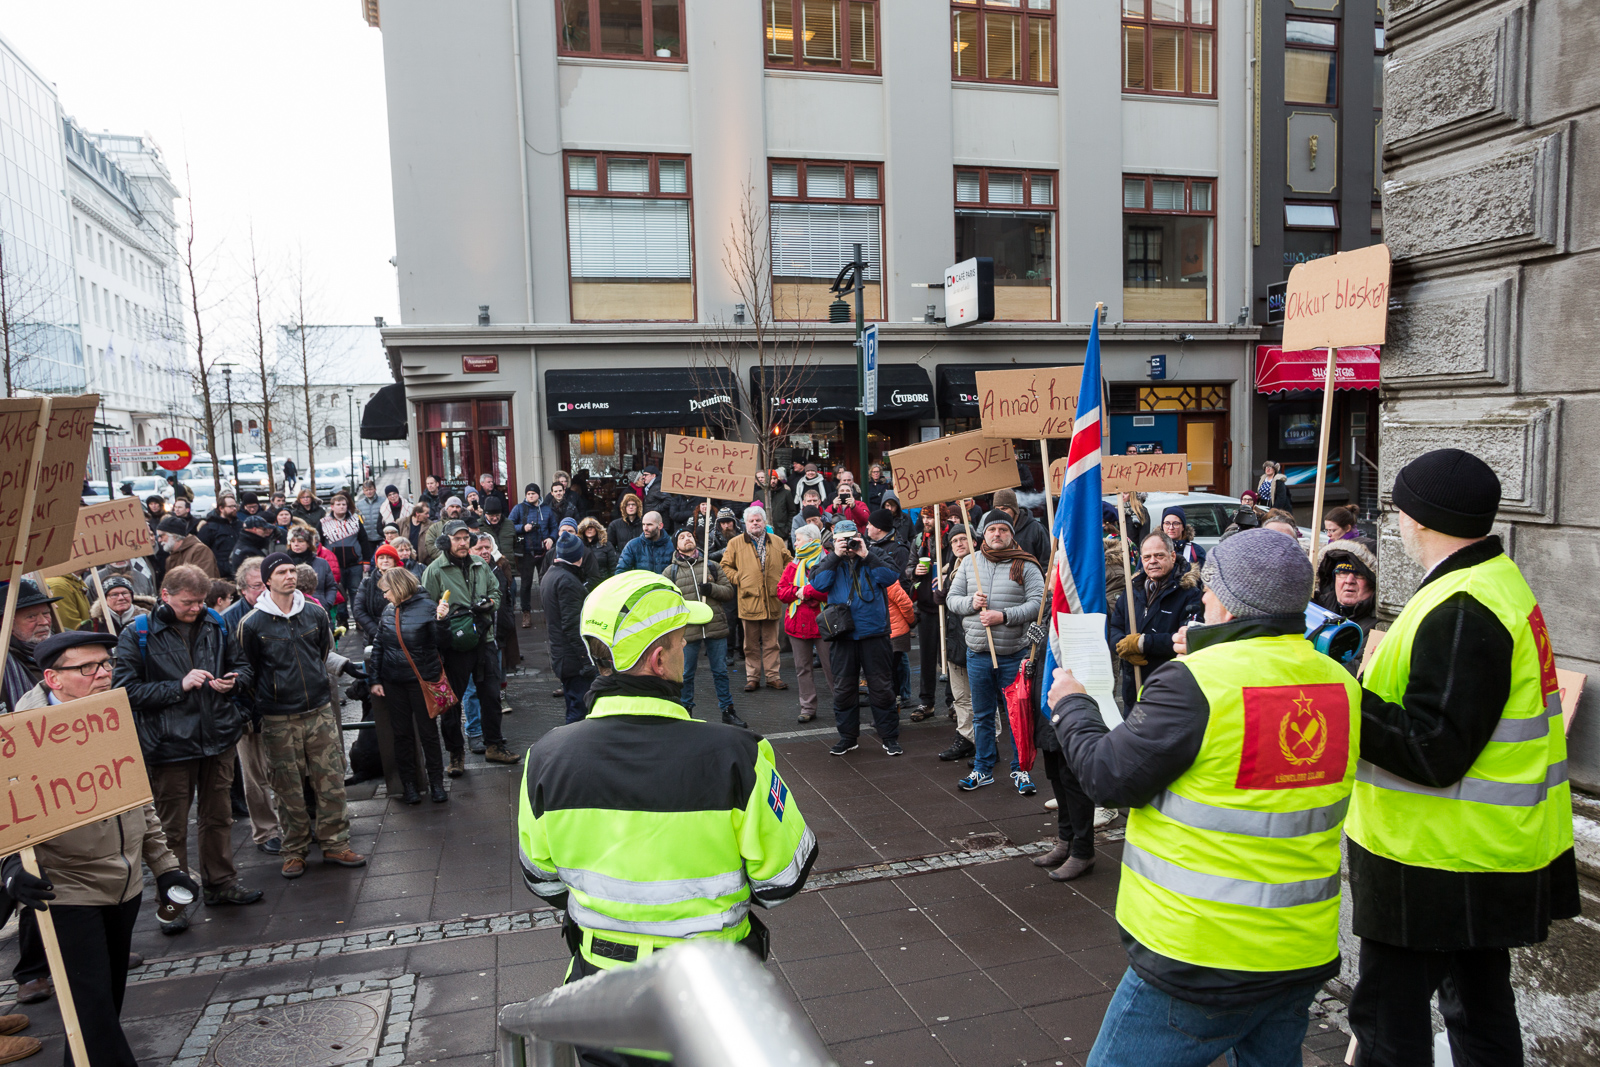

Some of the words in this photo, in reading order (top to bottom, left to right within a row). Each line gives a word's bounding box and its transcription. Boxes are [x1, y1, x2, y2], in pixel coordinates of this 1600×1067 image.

[1287, 291, 1330, 320] Okkur
[869, 339, 874, 364] P
[575, 402, 591, 410] CAFÉ
[689, 394, 731, 411] Premium
[892, 392, 929, 403] TUBORG
[982, 379, 1039, 420] Annað
[683, 457, 704, 474] þú
[712, 460, 735, 475] ert
[894, 456, 958, 500] Bjarni,
[85, 503, 134, 528] meiri
[26, 707, 120, 748] Vegna
